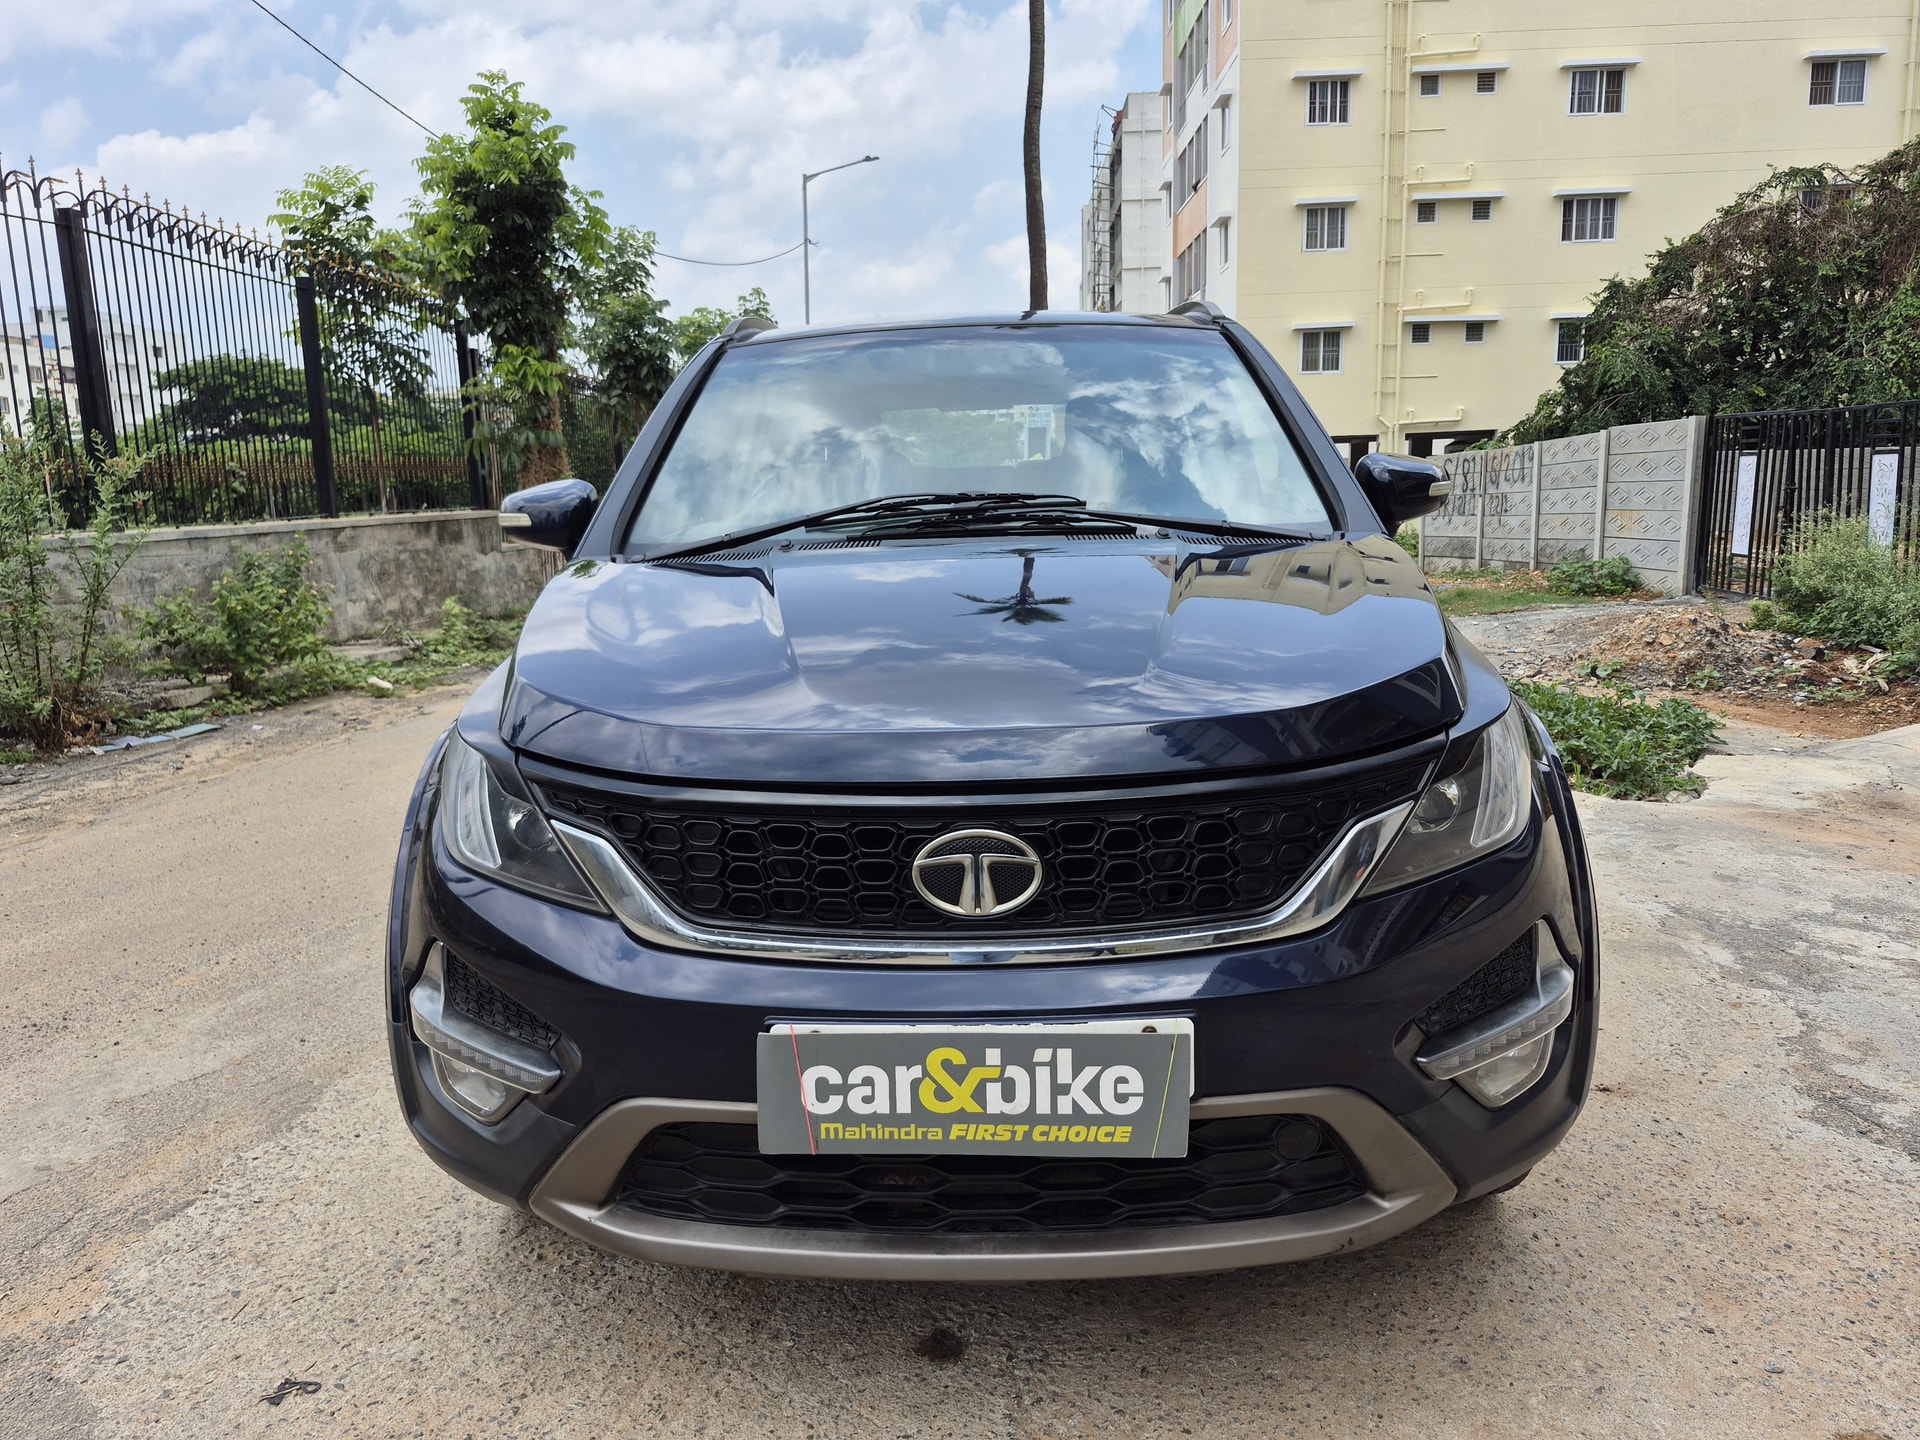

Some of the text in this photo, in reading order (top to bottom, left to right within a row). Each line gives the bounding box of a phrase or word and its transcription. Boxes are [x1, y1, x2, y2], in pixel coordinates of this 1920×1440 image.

[801, 1047, 1144, 1115] car&bike
[820, 1122, 1133, 1143] Mahindra FIRST CHOICE
